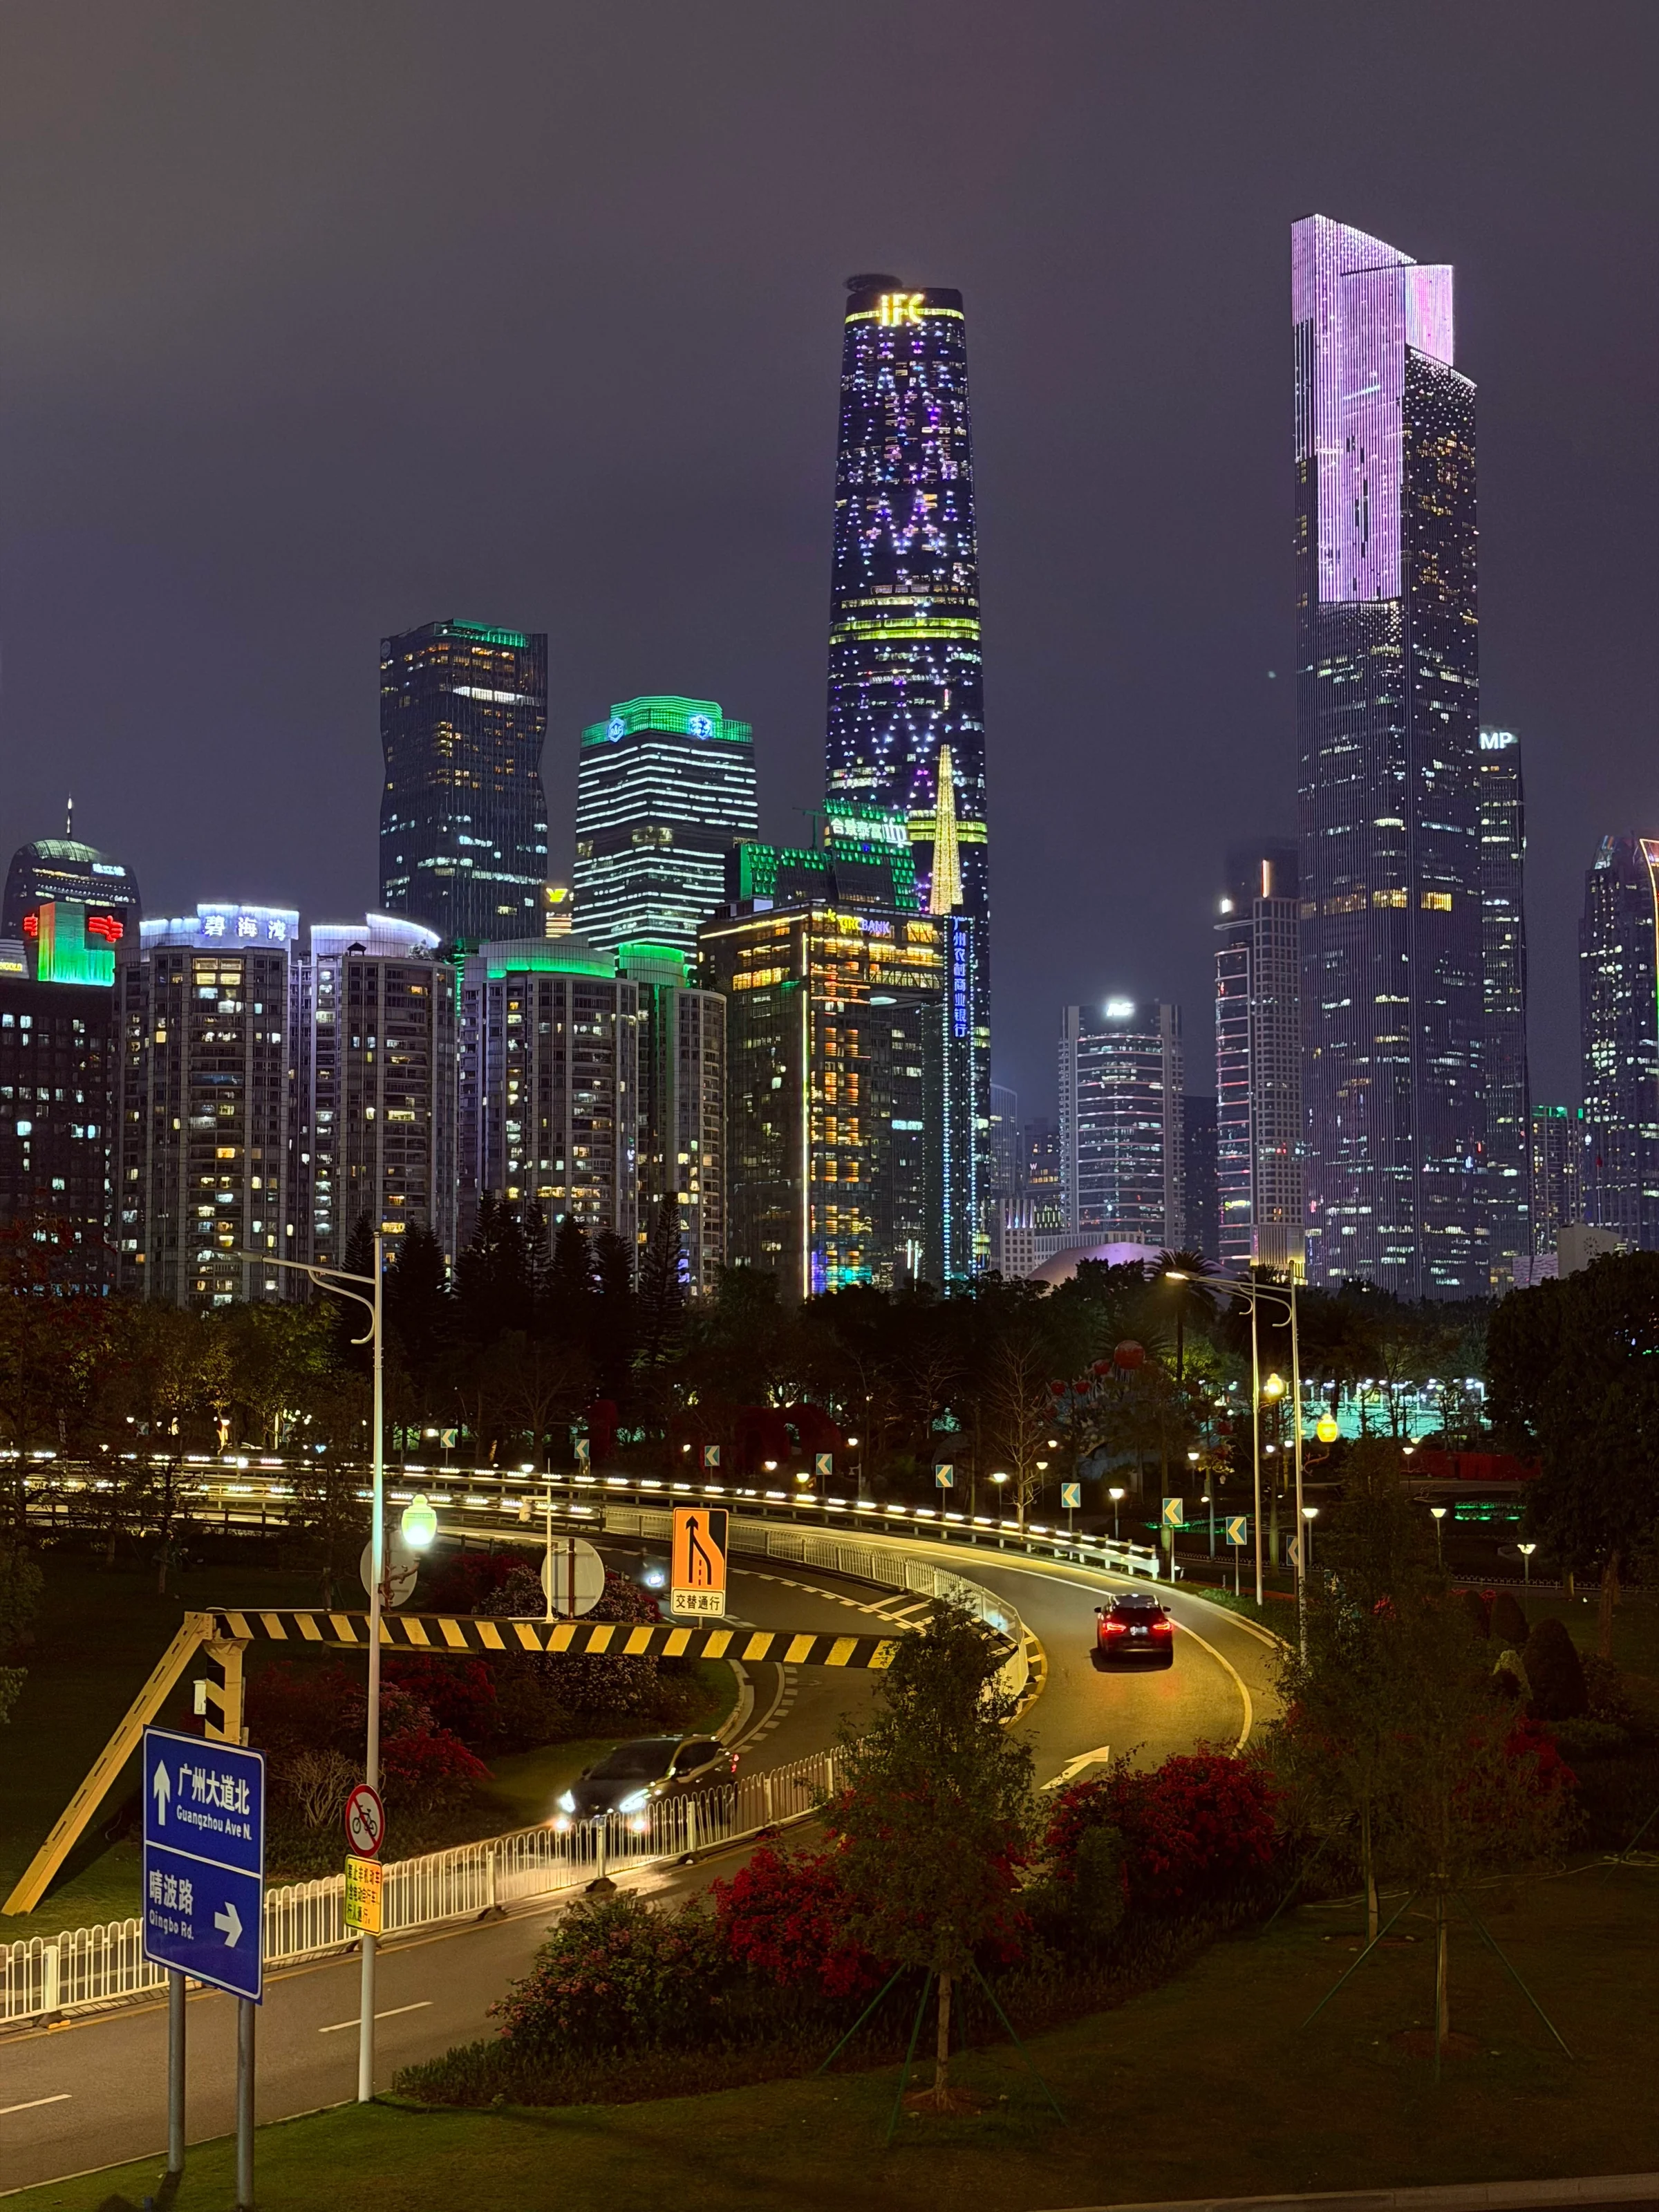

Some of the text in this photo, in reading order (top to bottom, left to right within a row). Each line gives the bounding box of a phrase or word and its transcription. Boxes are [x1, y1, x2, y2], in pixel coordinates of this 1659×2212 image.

[881, 294, 924, 326] IFC
[610, 724, 623, 736] R&F
[1481, 732, 1512, 749] MP
[204, 915, 286, 941] 碧海湾
[953, 917, 967, 1038] 广州农村商业银行
[675, 1594, 720, 1611] 交替通行
[178, 1763, 250, 1815] 广州大道北
[176, 1804, 252, 1840] Guangzhou Ave N.
[149, 1909, 194, 1940] Qingbo Rd.
